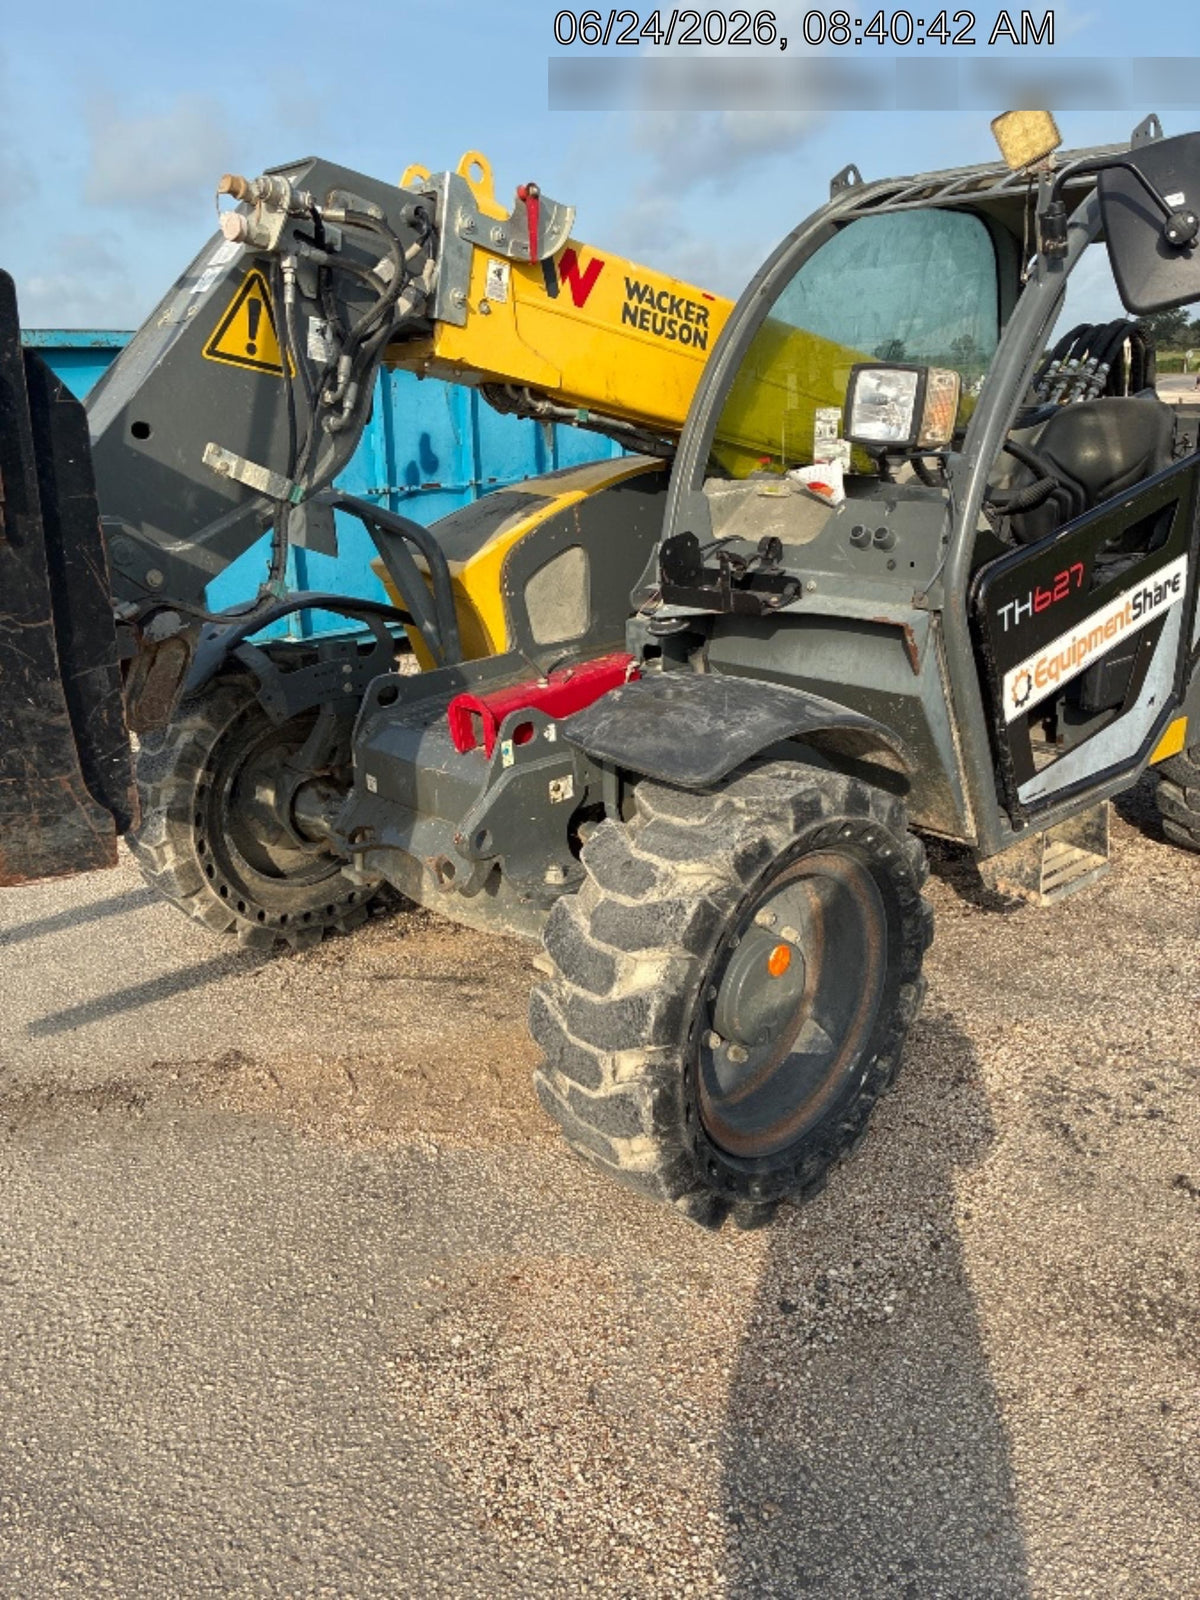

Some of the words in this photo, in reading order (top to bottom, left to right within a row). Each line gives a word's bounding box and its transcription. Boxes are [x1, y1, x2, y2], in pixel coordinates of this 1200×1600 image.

[621, 302, 708, 350] NEUSON
[624, 276, 709, 329] WACKER
[997, 561, 1084, 632] TH627
[1034, 572, 1181, 688] EquipmentShare
